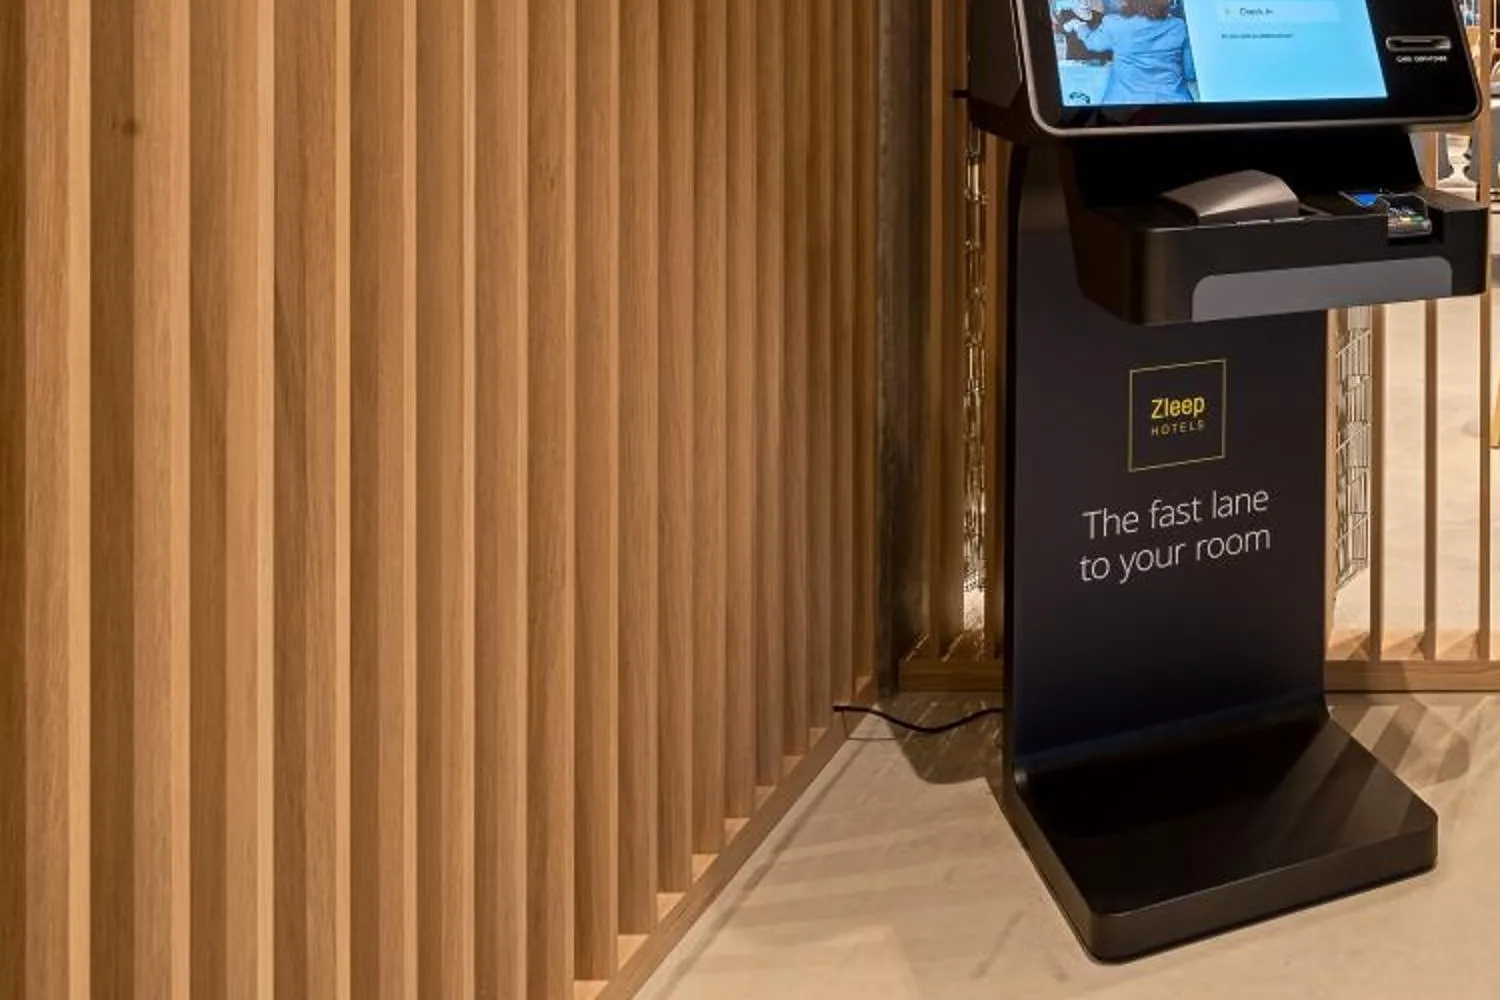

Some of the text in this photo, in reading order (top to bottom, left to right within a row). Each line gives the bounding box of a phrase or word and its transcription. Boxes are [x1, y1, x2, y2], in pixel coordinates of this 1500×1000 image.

[1151, 396, 1205, 419] Zleep
[1151, 419, 1205, 436] HOTELS
[1082, 490, 1269, 539] The fast lane
[1079, 529, 1270, 584] to your room
